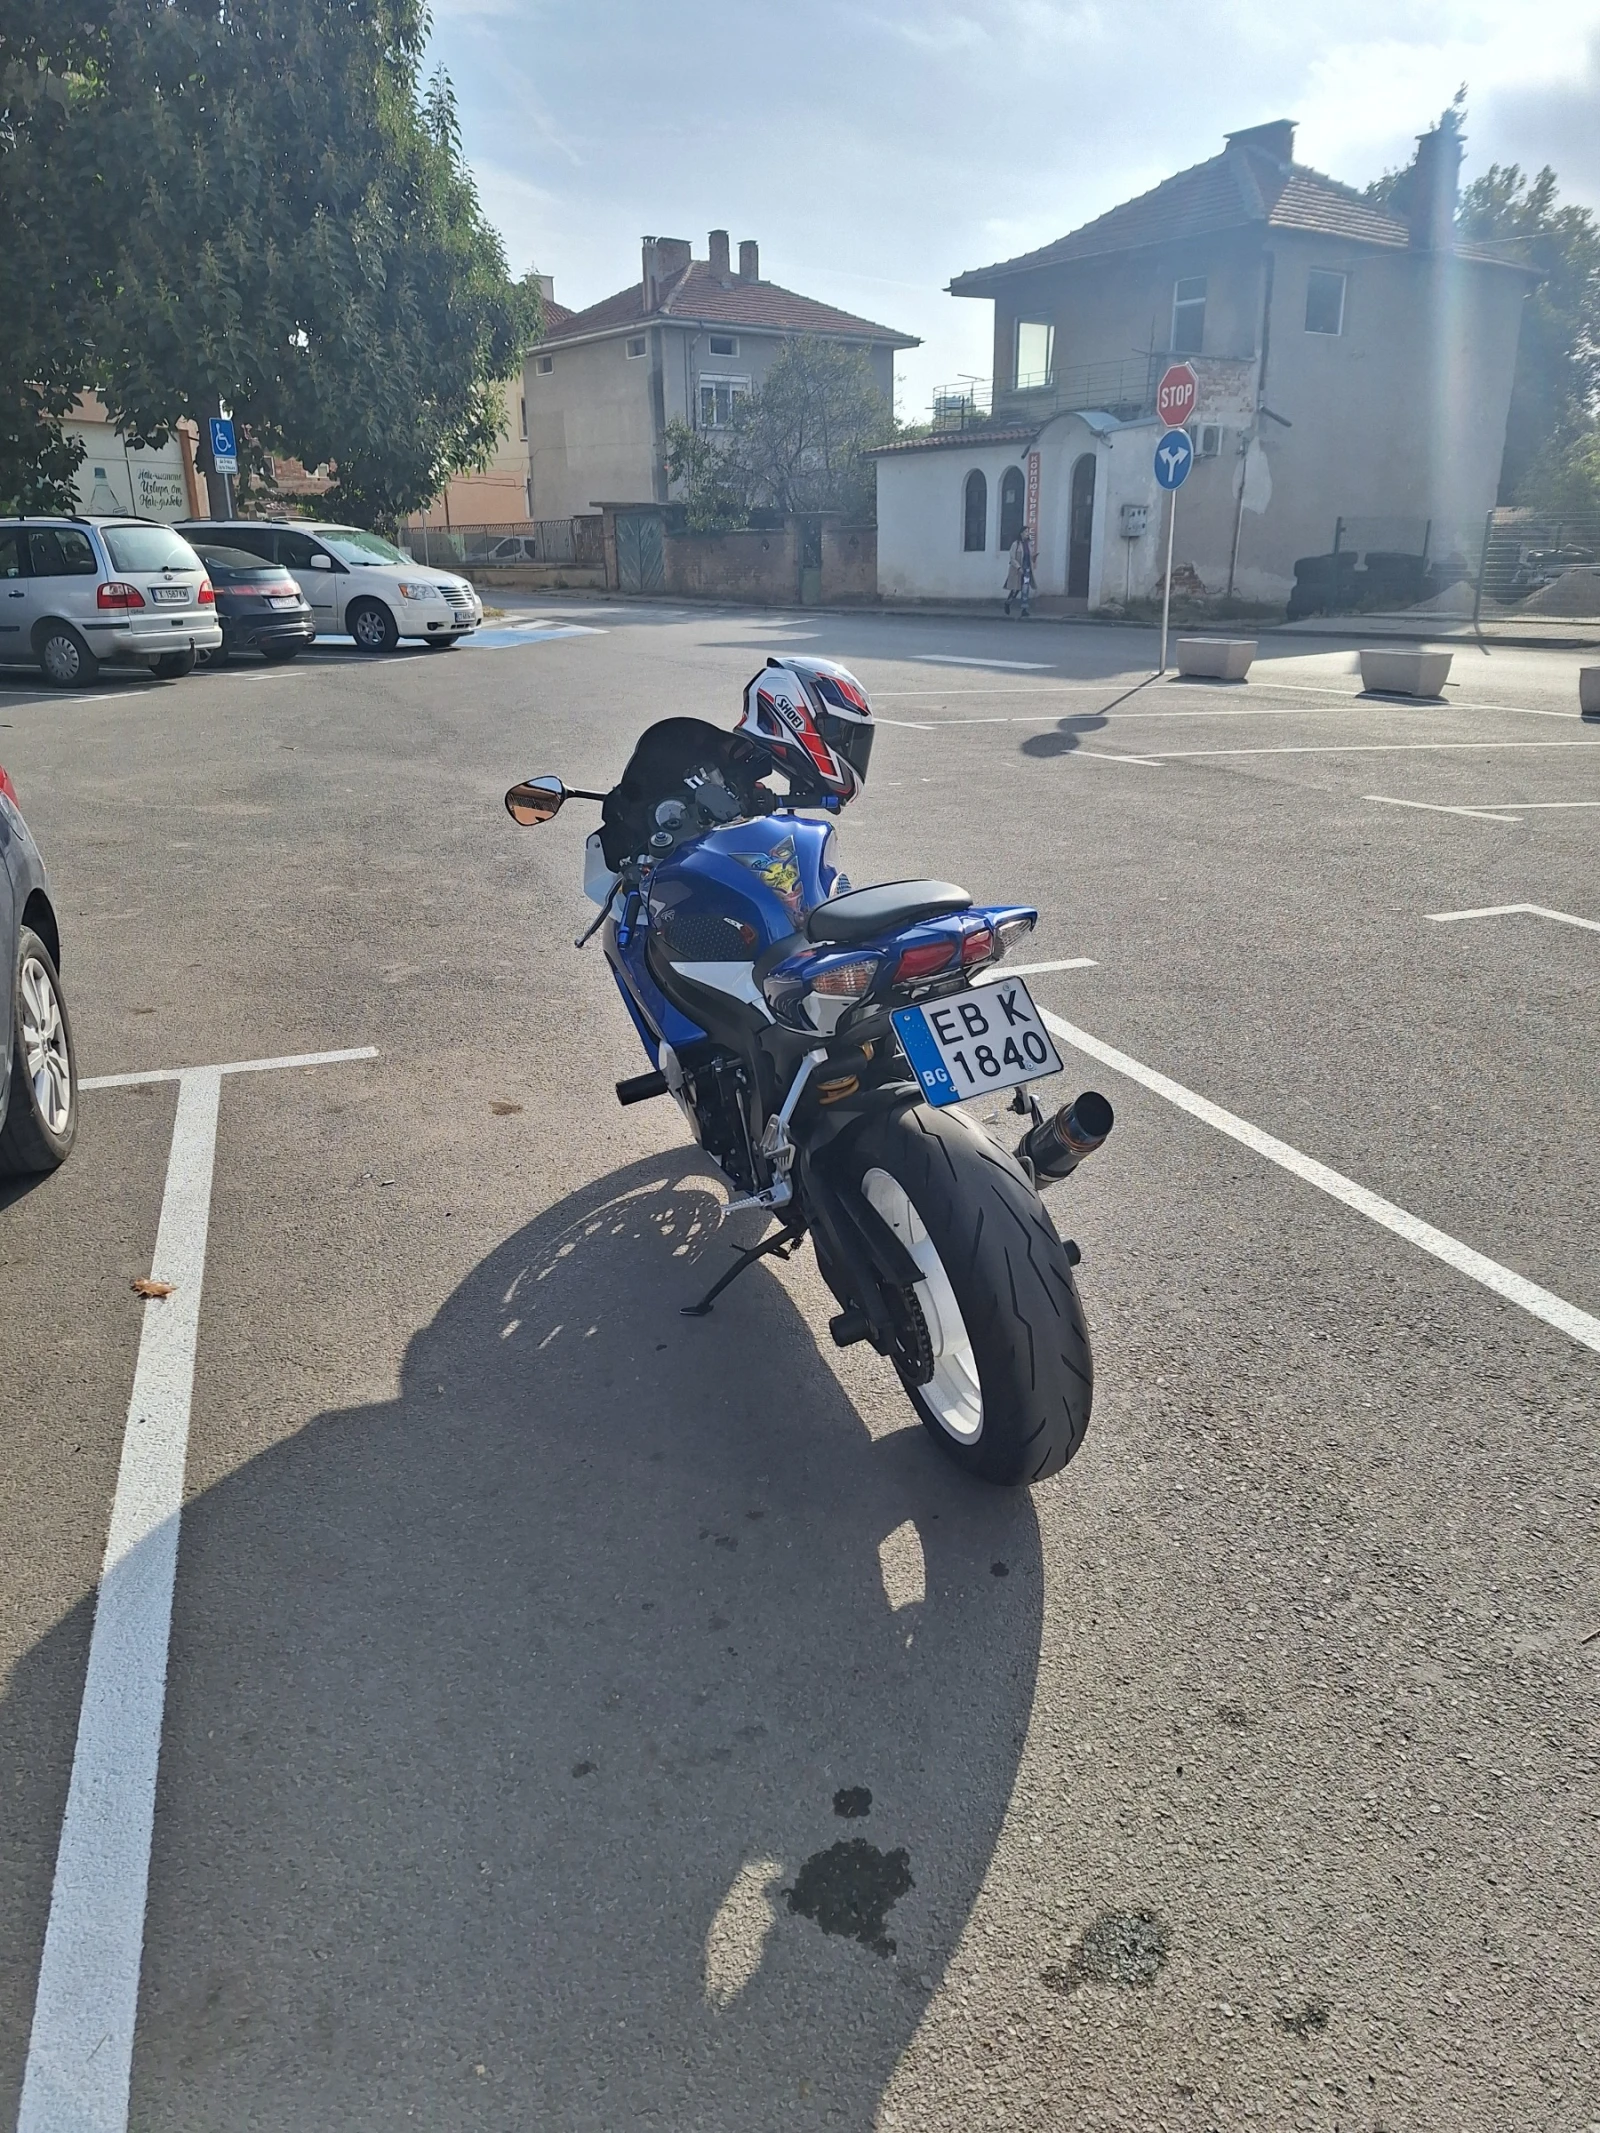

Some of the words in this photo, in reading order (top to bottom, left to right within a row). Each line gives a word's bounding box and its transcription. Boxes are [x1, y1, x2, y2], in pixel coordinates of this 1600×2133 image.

[1161, 384, 1193, 408] STOP
[1029, 455, 1039, 524] КОМПЮТЪРЕН
[777, 698, 803, 728] SHOEI
[929, 1002, 990, 1046] EB
[997, 990, 1031, 1026] K
[921, 1067, 948, 1087] BG
[953, 1030, 1048, 1084] 1840
